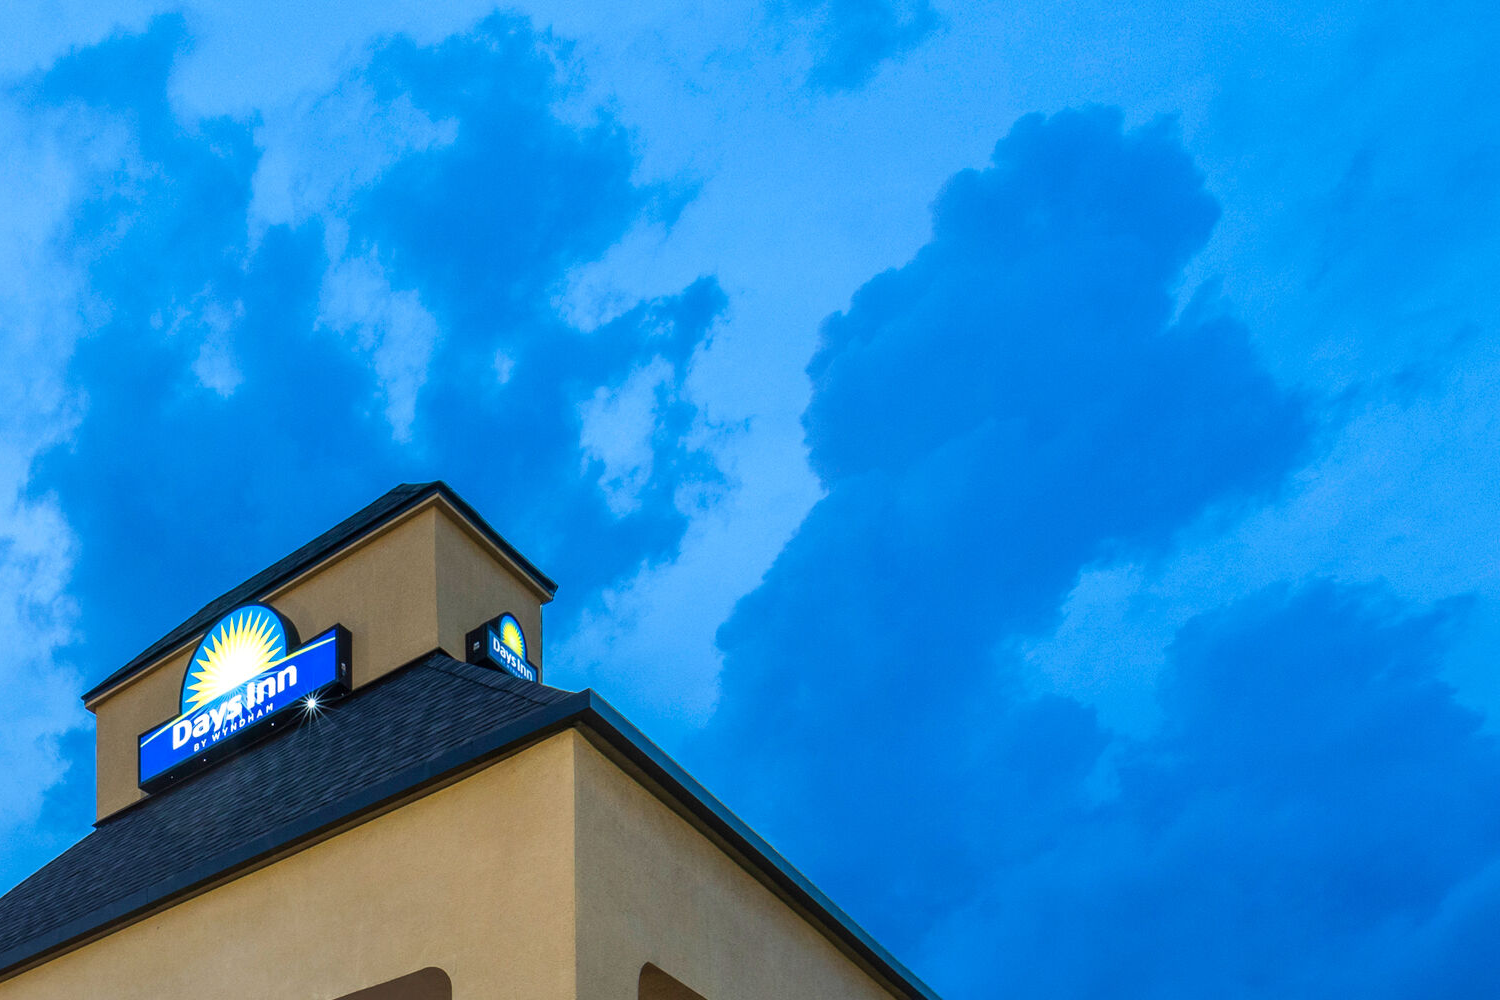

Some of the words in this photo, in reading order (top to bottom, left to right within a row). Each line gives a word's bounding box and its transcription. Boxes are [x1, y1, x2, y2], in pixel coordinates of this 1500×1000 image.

[493, 637, 516, 668] Days
[517, 658, 533, 682] Inn
[172, 695, 242, 750] Days
[247, 665, 298, 707] Inn
[193, 739, 207, 752] BY
[211, 703, 274, 742] WYNDHAM
